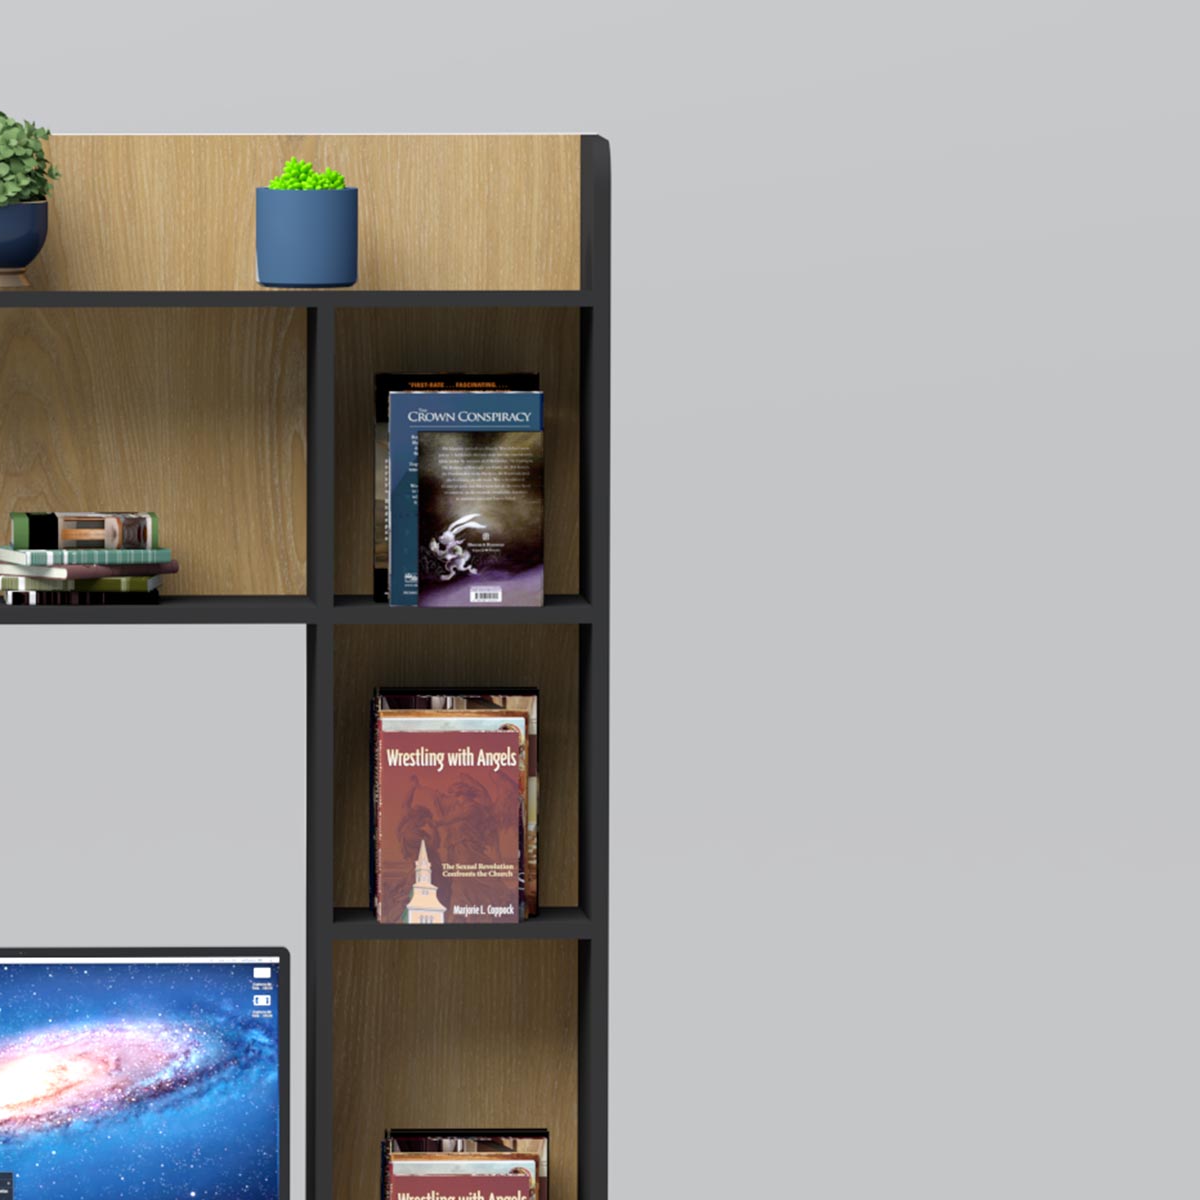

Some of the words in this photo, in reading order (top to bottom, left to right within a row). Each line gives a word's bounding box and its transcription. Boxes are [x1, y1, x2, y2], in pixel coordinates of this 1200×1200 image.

[407, 411, 456, 422] CROWN
[457, 411, 532, 422] CONSPIRACY
[386, 746, 445, 772] Wrestling
[447, 746, 474, 767] with
[477, 746, 517, 772] Angels
